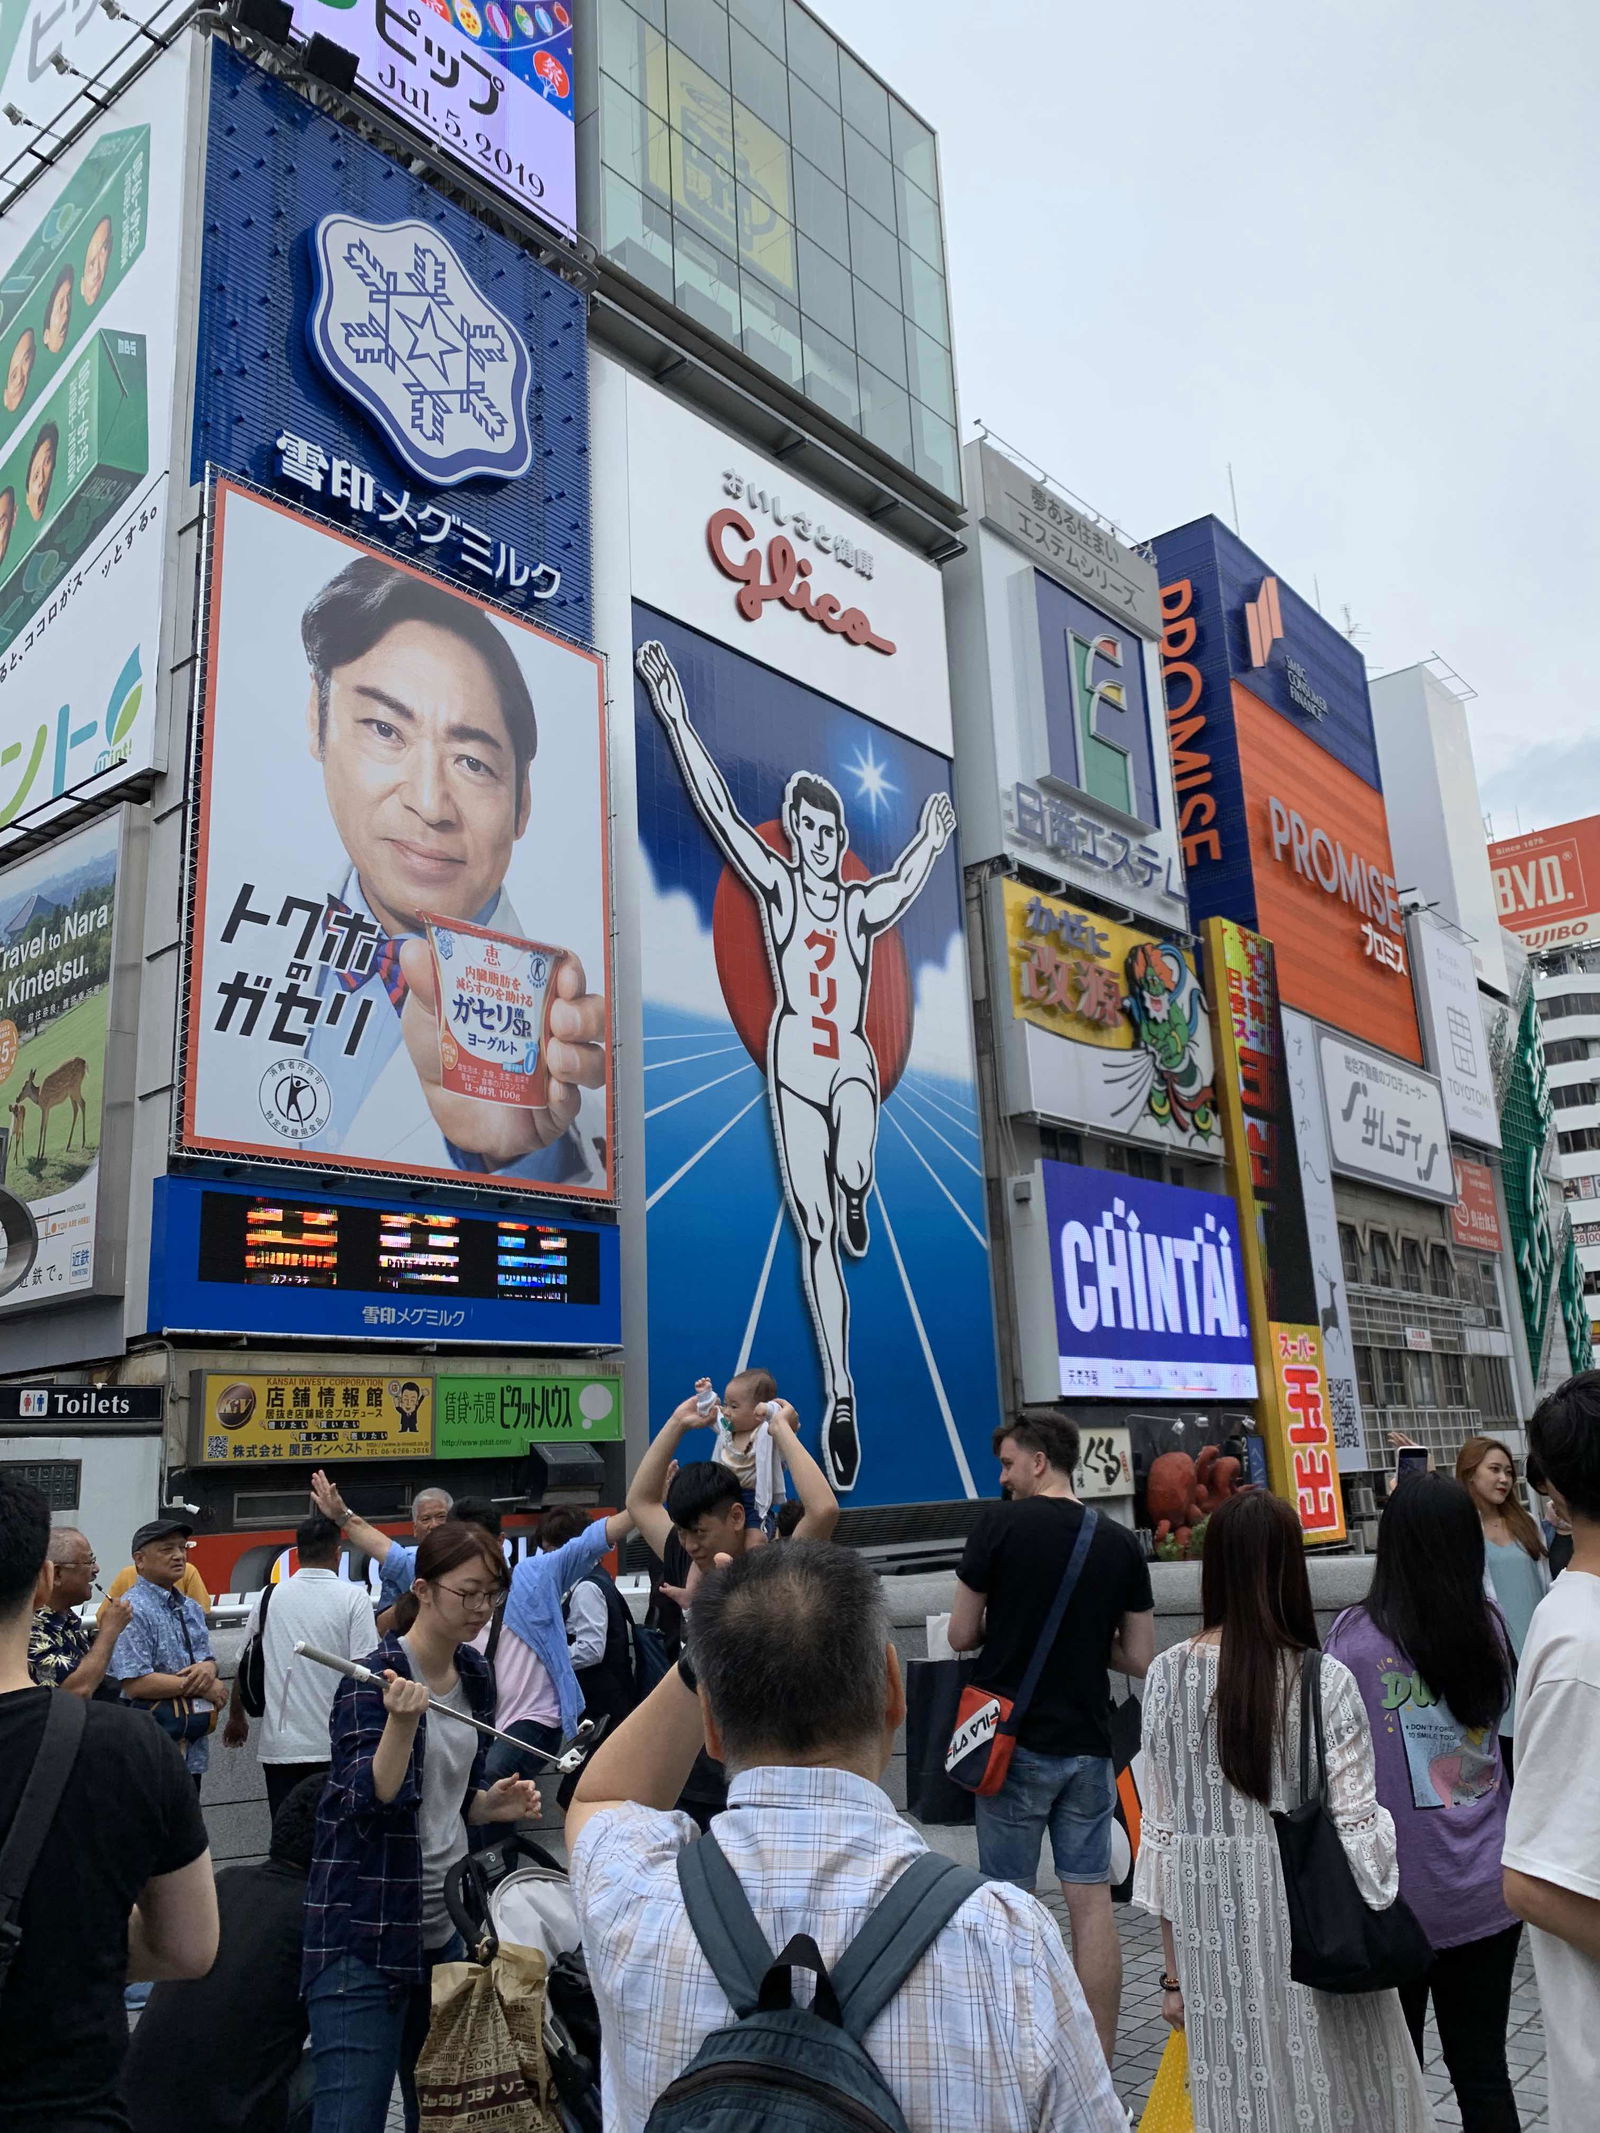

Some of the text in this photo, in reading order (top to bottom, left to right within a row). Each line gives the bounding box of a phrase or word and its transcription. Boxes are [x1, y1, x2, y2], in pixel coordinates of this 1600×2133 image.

[376, 0, 505, 116] ピップ
[378, 64, 545, 199] Jul. 5, 2019
[277, 430, 562, 600] 雪印メグミルク
[1030, 484, 1120, 563] 夢ある住まい
[706, 507, 897, 657] Glico
[1018, 511, 1137, 612] エステムシリーズ
[1287, 670, 1329, 714] CONSUMER
[1289, 685, 1323, 722] FINANCE
[1268, 796, 1402, 936] PROMISE
[1491, 854, 1575, 917] B.V.D.
[48, 932, 61, 952] to
[64, 904, 109, 944] Nara
[220, 882, 382, 973] トクホ
[1024, 895, 1111, 959] かぜに
[483, 944, 502, 967] 恵
[1361, 923, 1408, 977] プロミス
[7, 954, 90, 1008] Kintetsu.
[286, 961, 312, 982] の
[456, 976, 533, 1007] 減らすのを助ける
[465, 966, 521, 991] 内臓脂肪を
[1019, 941, 1125, 1028] 改源
[214, 970, 374, 1058] ガセリ
[452, 993, 513, 1033] ガセリ
[804, 928, 840, 1061] グリコ
[468, 1032, 518, 1055] ヨーグルト
[464, 1081, 521, 1102] はっ酵乳 100g
[265, 1110, 324, 1138] 特定保健用食品
[71, 1248, 90, 1268] 近鉄
[1060, 1196, 1242, 1338] CHINTAI
[362, 1305, 466, 1328] 雪印メグミルク
[1279, 1332, 1317, 1359] スーパー
[266, 1377, 384, 1387] KANSAI INVEST CORPORATION
[266, 1386, 383, 1408] 店舗情報館
[54, 1392, 130, 1415] Toilets
[265, 1408, 383, 1419] 居抜き店舗総合プロデュース
[444, 1390, 496, 1425] 賃貸・売買
[500, 1384, 573, 1430] ピタットハウス
[232, 1442, 362, 1459] 株式会社 関西インベスト
[1283, 1364, 1338, 1531] 玉出
[466, 2057, 501, 2073] SONY
[467, 2103, 516, 2124] DAIKIN
